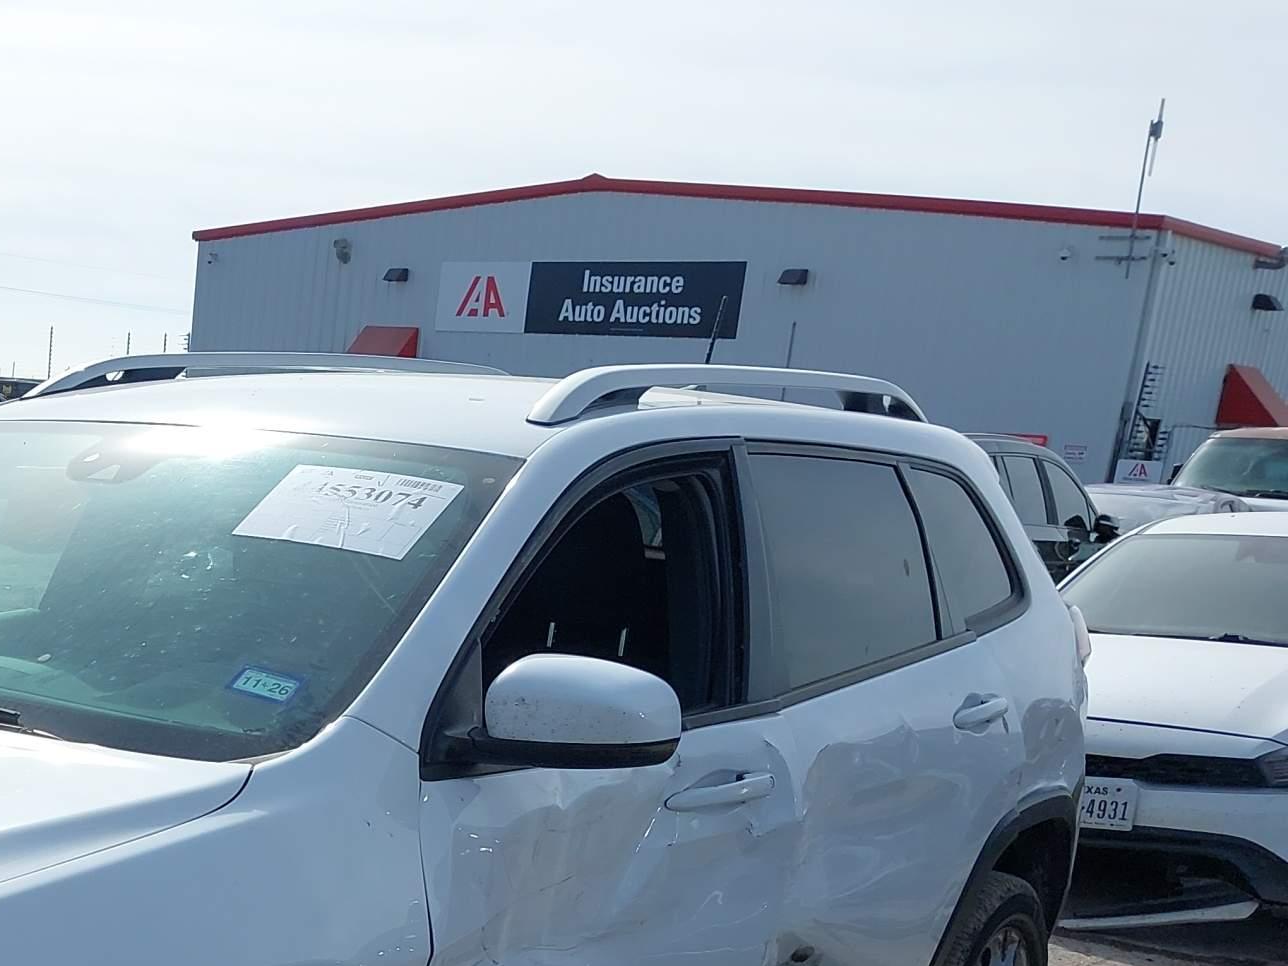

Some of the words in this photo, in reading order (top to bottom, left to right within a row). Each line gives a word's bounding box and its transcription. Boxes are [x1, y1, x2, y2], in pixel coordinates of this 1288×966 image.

[582, 269, 685, 294] Insurance
[558, 299, 605, 323] Auto
[610, 299, 702, 325] Auctions
